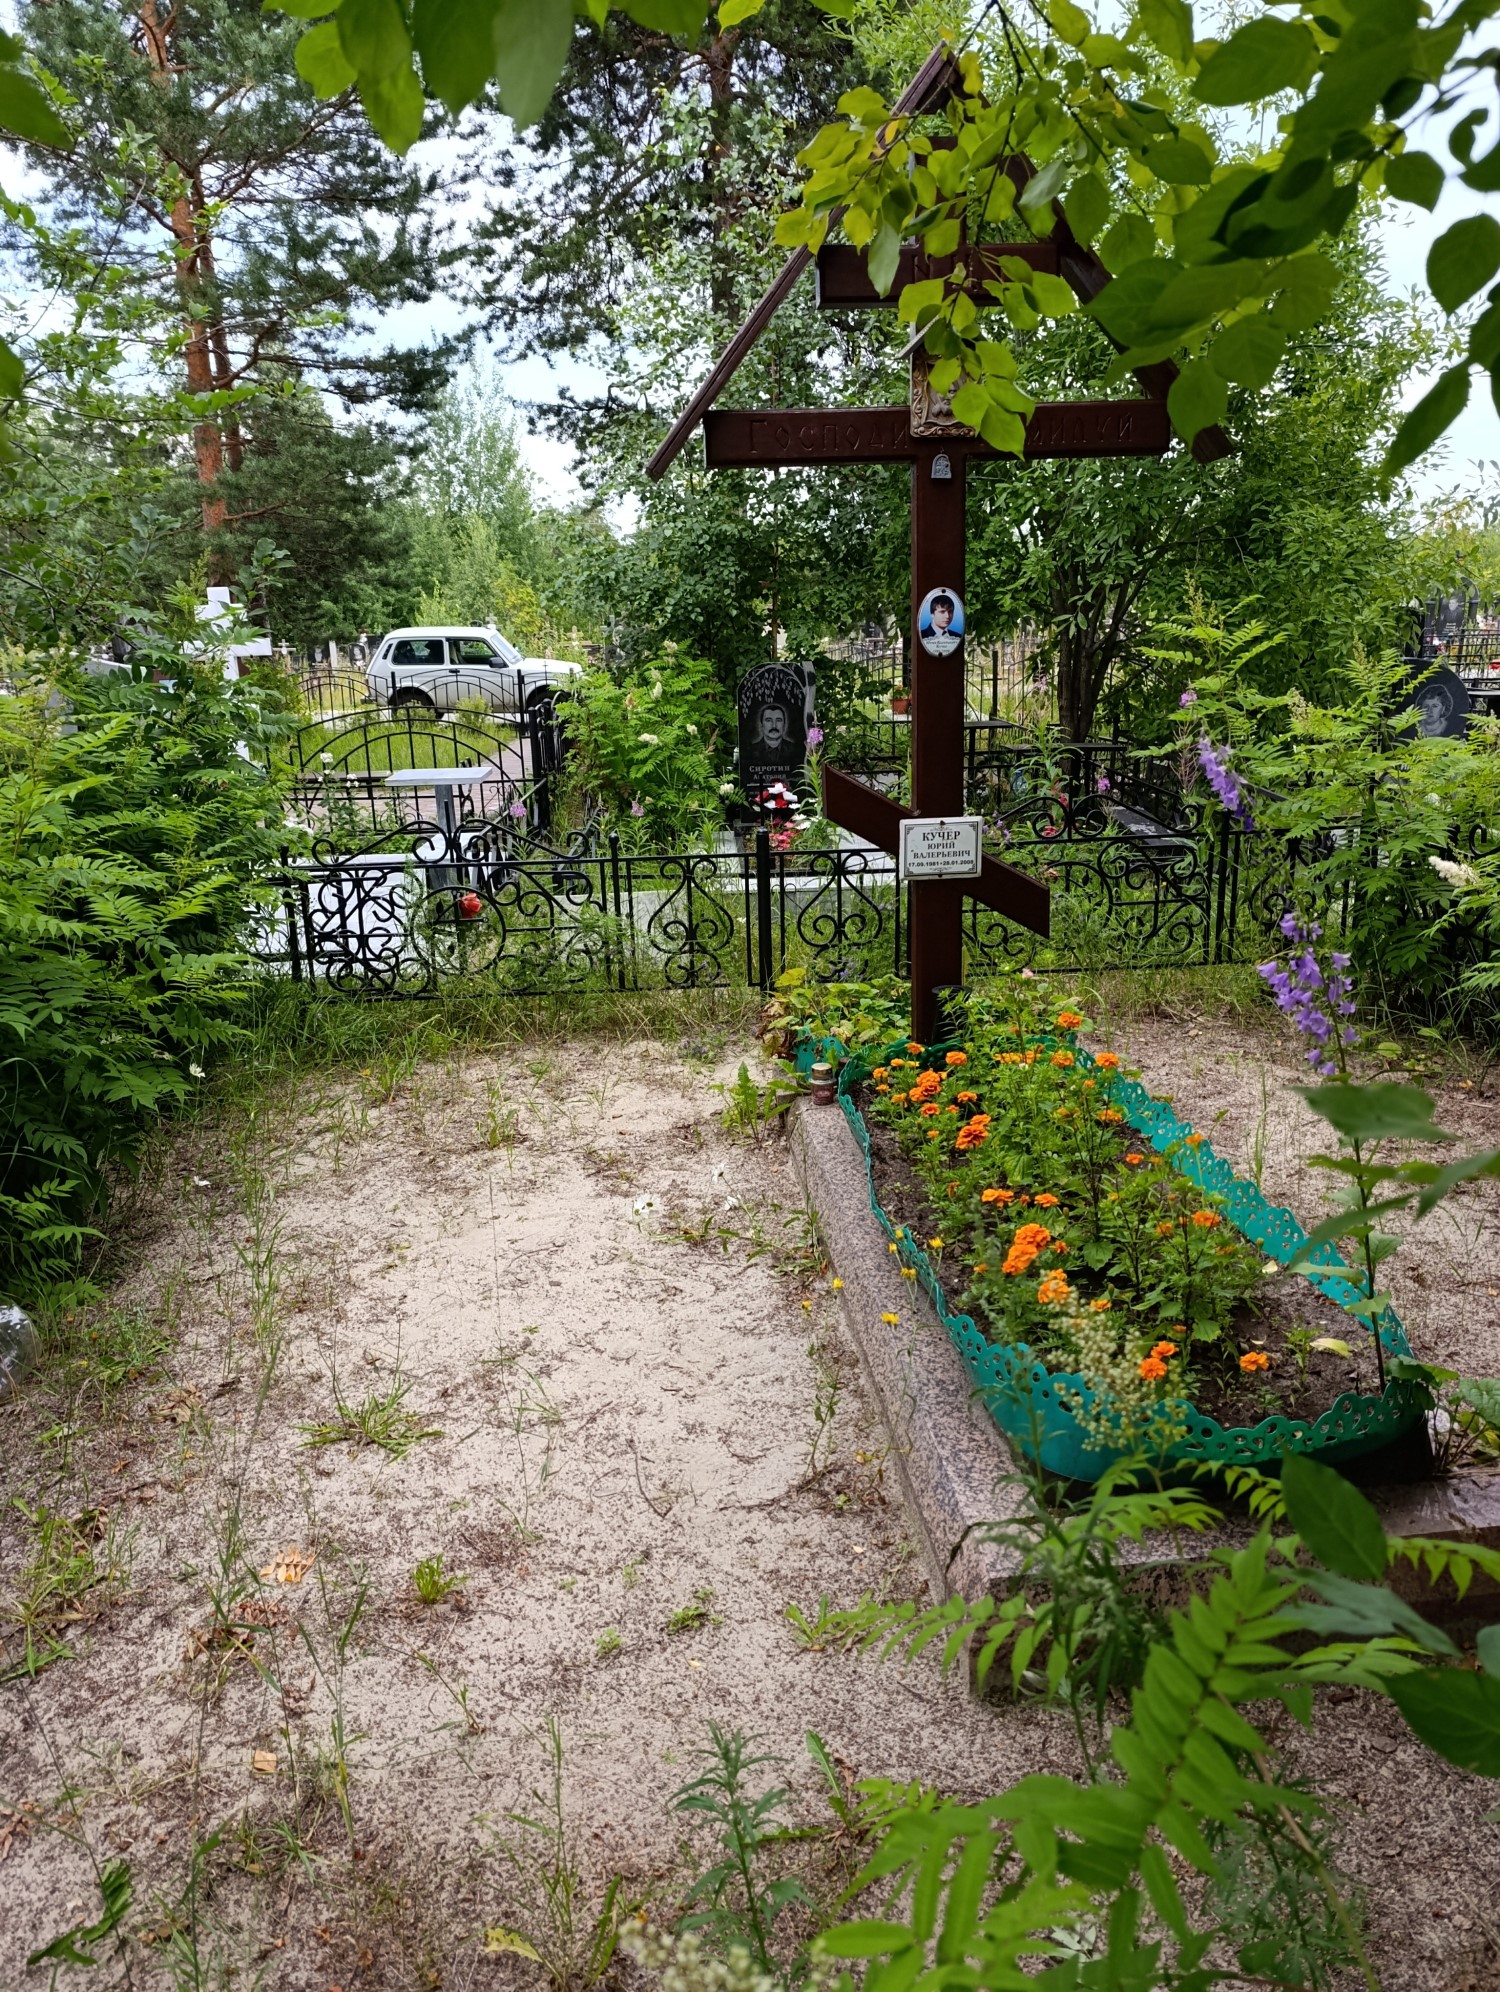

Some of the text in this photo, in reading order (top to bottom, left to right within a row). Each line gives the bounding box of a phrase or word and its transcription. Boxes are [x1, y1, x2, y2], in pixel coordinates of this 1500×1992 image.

[922, 831, 961, 841] КУЧЕР
[927, 841, 955, 850] ЮРИЙ
[913, 850, 971, 859] ВАЛЕРЬЕВИЧ
